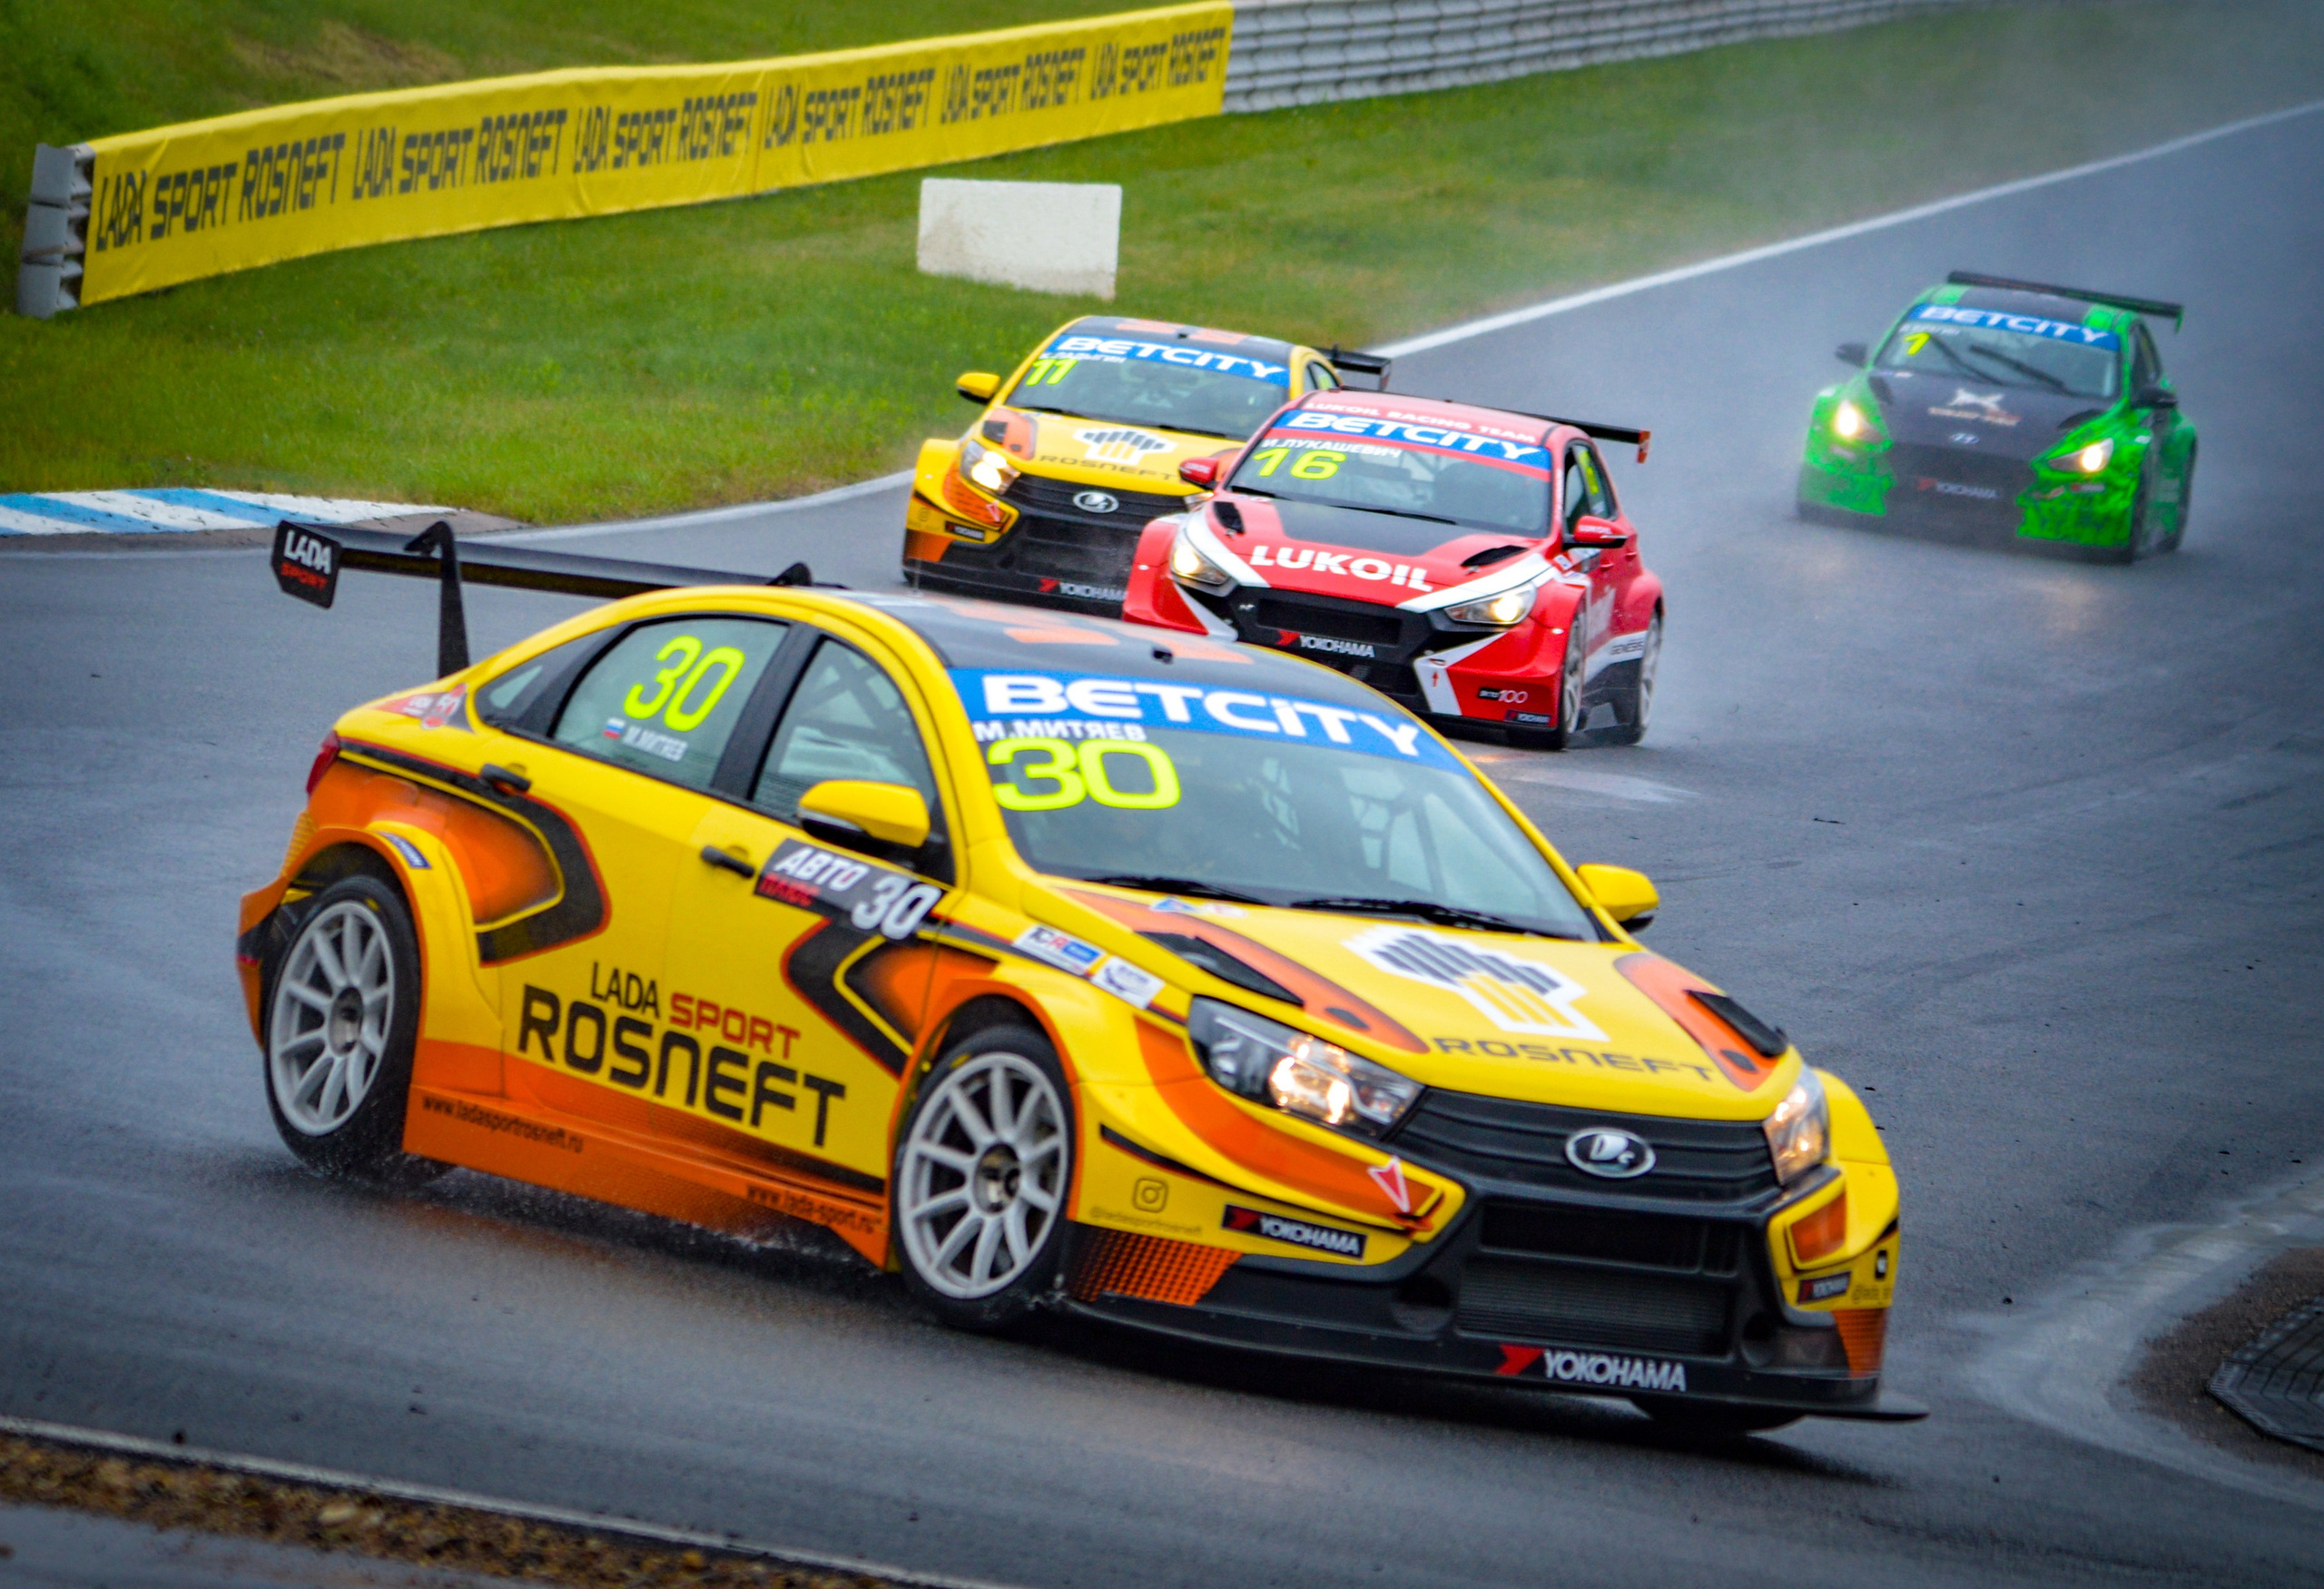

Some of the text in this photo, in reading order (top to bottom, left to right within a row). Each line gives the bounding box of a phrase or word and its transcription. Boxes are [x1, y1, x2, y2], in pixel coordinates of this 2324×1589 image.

[95, 27, 1226, 252] LADA SPORT ROSNEFT LADA SPORT ROSNEFT LADA SPORT ROSNEFT LADA SPORT ROSNEFT LADA SPORT ROSNEFT LADA SPORT ROSNEFT
[1920, 306, 2109, 342] BETCITY
[1025, 359, 1078, 386] 11
[1058, 337, 1285, 378] BETCITY
[1287, 412, 1541, 459] BETCITY
[1305, 402, 1537, 442] LUKOIL RACING TEAM
[1039, 455, 1177, 480] ROSNEFT
[1253, 447, 1346, 479] 16
[283, 529, 331, 575] LADA
[1249, 545, 1433, 592] LUKOIL
[1298, 635, 1376, 658] YOKOHAMA
[623, 635, 746, 732] 30
[971, 719, 1147, 742] М.МИТЯЕВ
[983, 675, 1421, 757] BETCITY
[987, 736, 1181, 812] 30
[773, 846, 942, 941] АВТО 30
[591, 960, 801, 1060] LADA SPORT
[517, 983, 846, 1148] ROSNEFT
[1433, 1037, 1712, 1081] ROSNEFT
[1260, 1216, 1360, 1255] YOKOHAMA
[1544, 1348, 1687, 1392] YOKOHAMA
